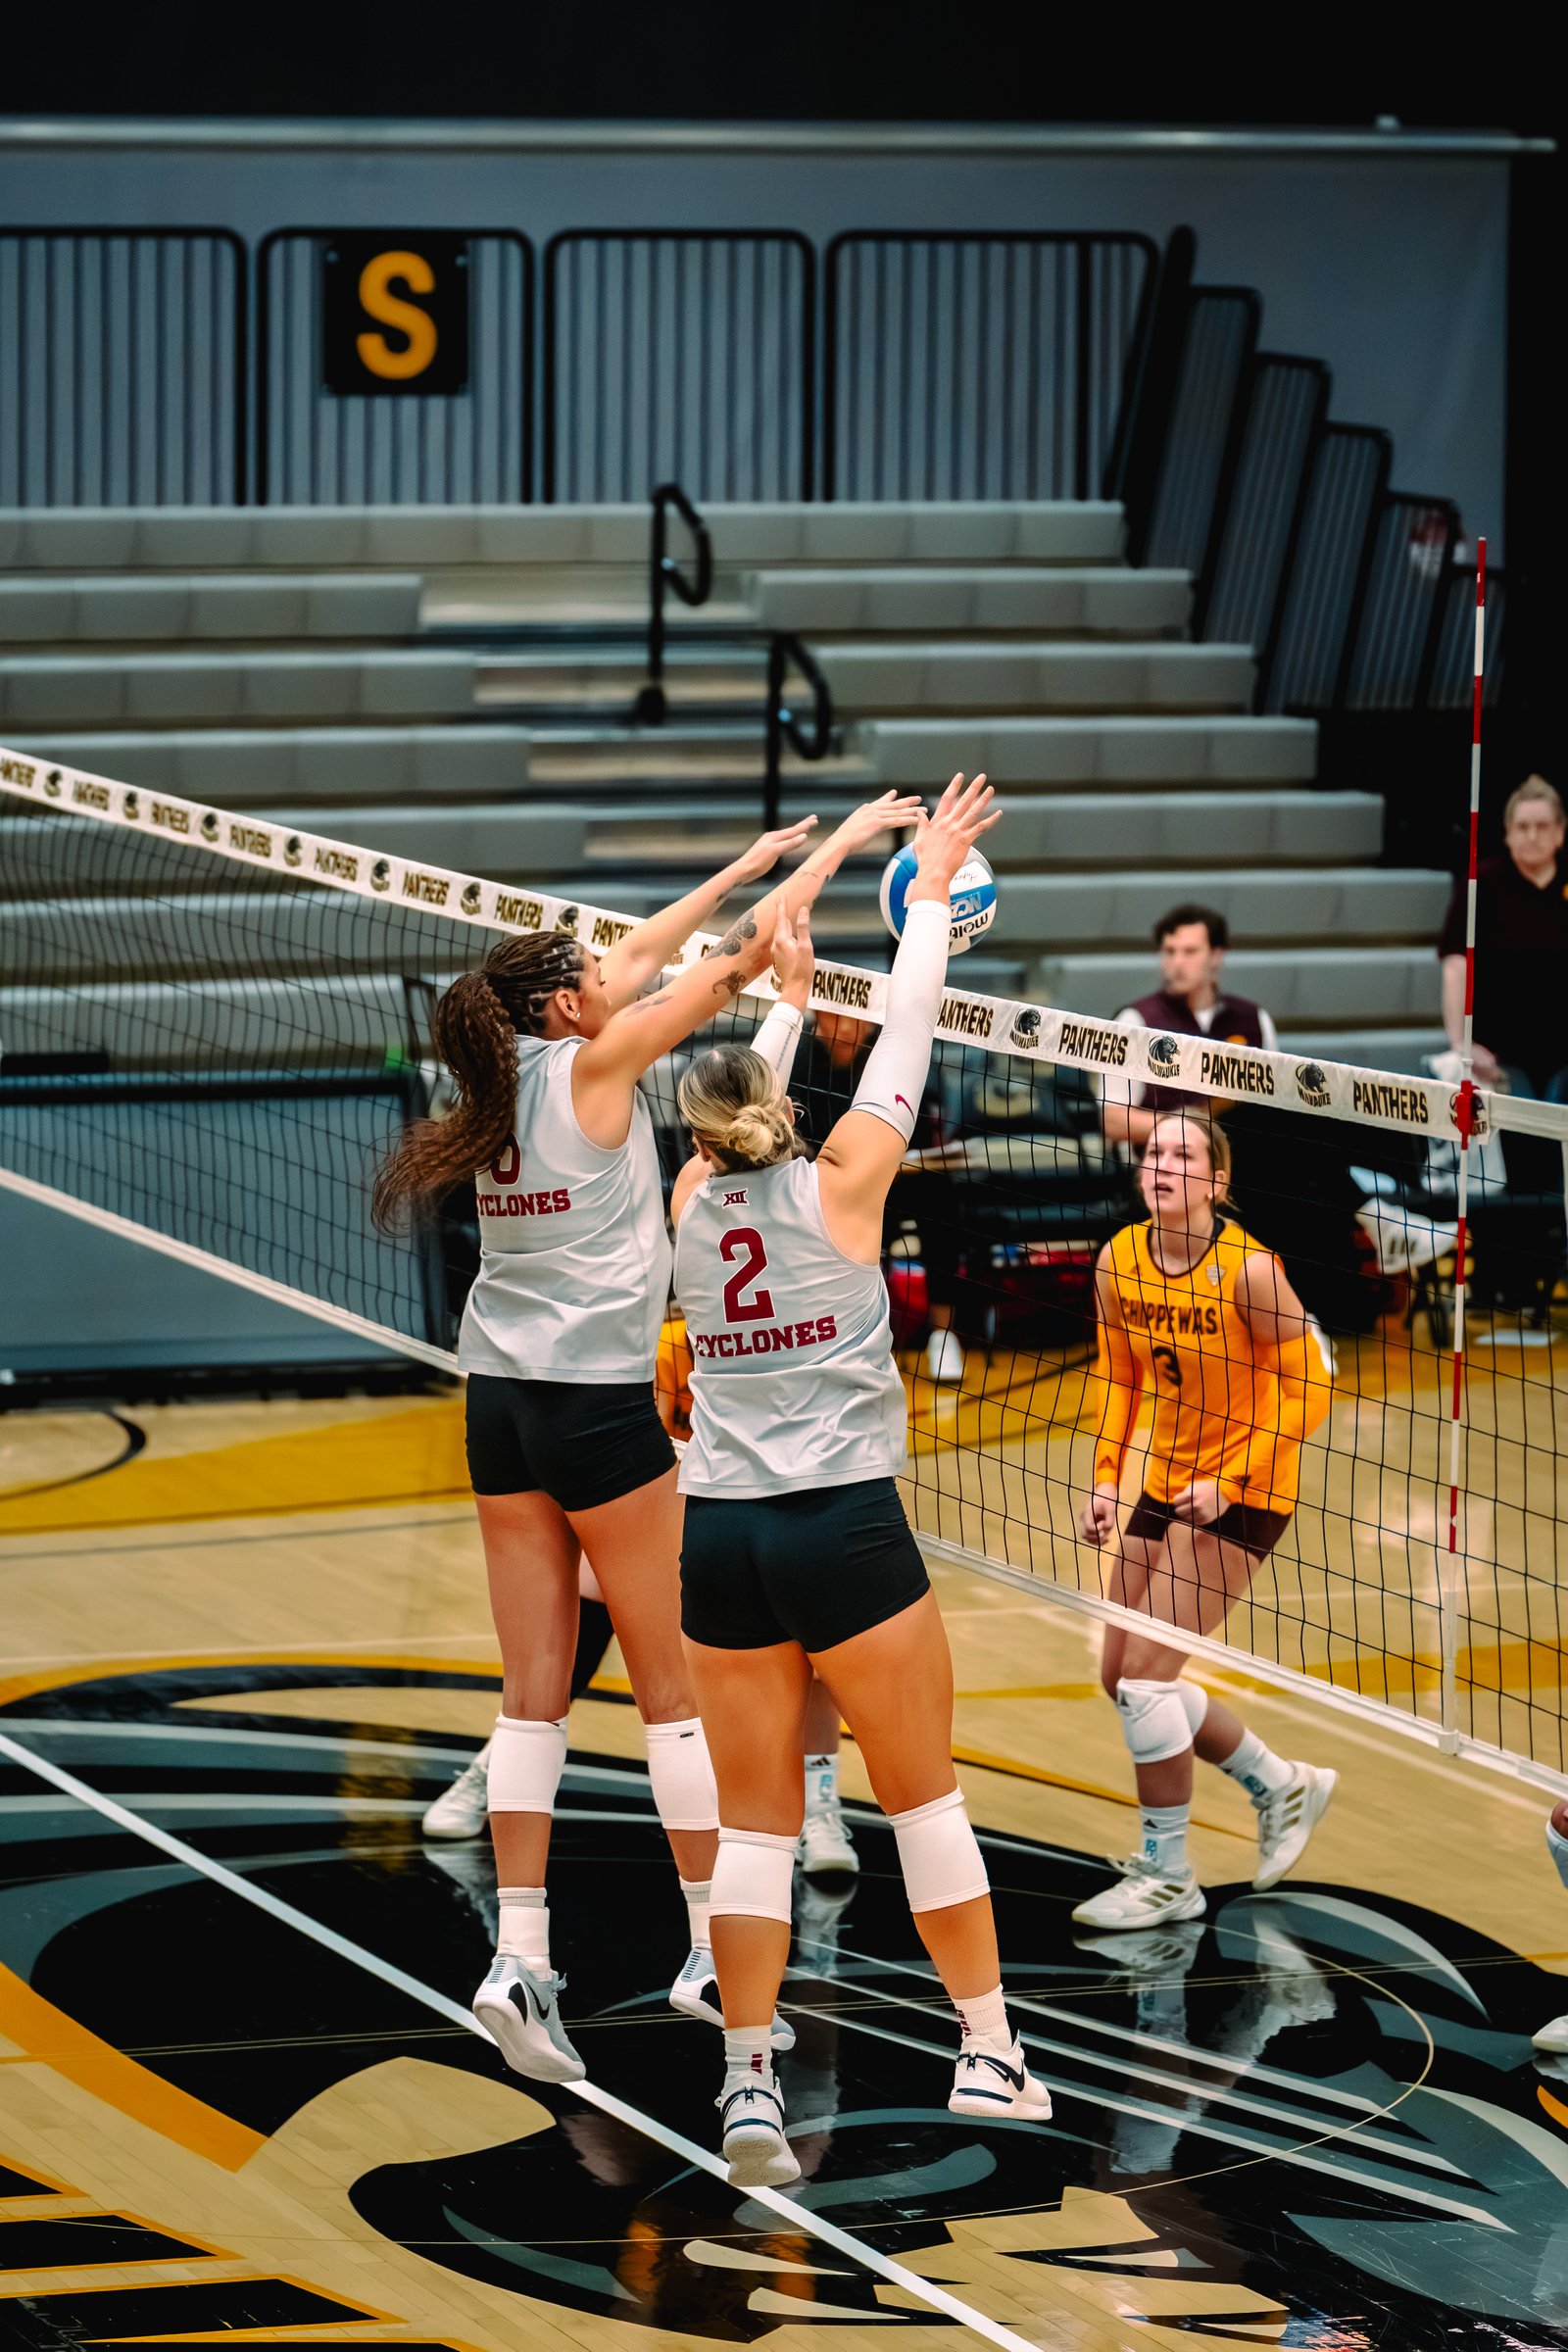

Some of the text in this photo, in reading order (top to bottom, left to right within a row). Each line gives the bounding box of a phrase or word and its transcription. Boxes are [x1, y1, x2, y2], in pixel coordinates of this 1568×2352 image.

[357, 250, 438, 380] S
[494, 894, 544, 930] PANTHERS
[951, 892, 983, 918] NCA
[950, 912, 989, 939] molt
[811, 969, 872, 1009] PANTHERS
[937, 998, 994, 1038] ANTHERS
[1058, 1023, 1128, 1066] PANTHERS
[1200, 1052, 1275, 1096] PANTHERS
[1353, 1080, 1429, 1124] PANTHERS
[477, 1189, 571, 1217] YCLONES
[723, 1189, 749, 1207] XII
[719, 1227, 776, 1324] 2
[1152, 1346, 1183, 1388] 3
